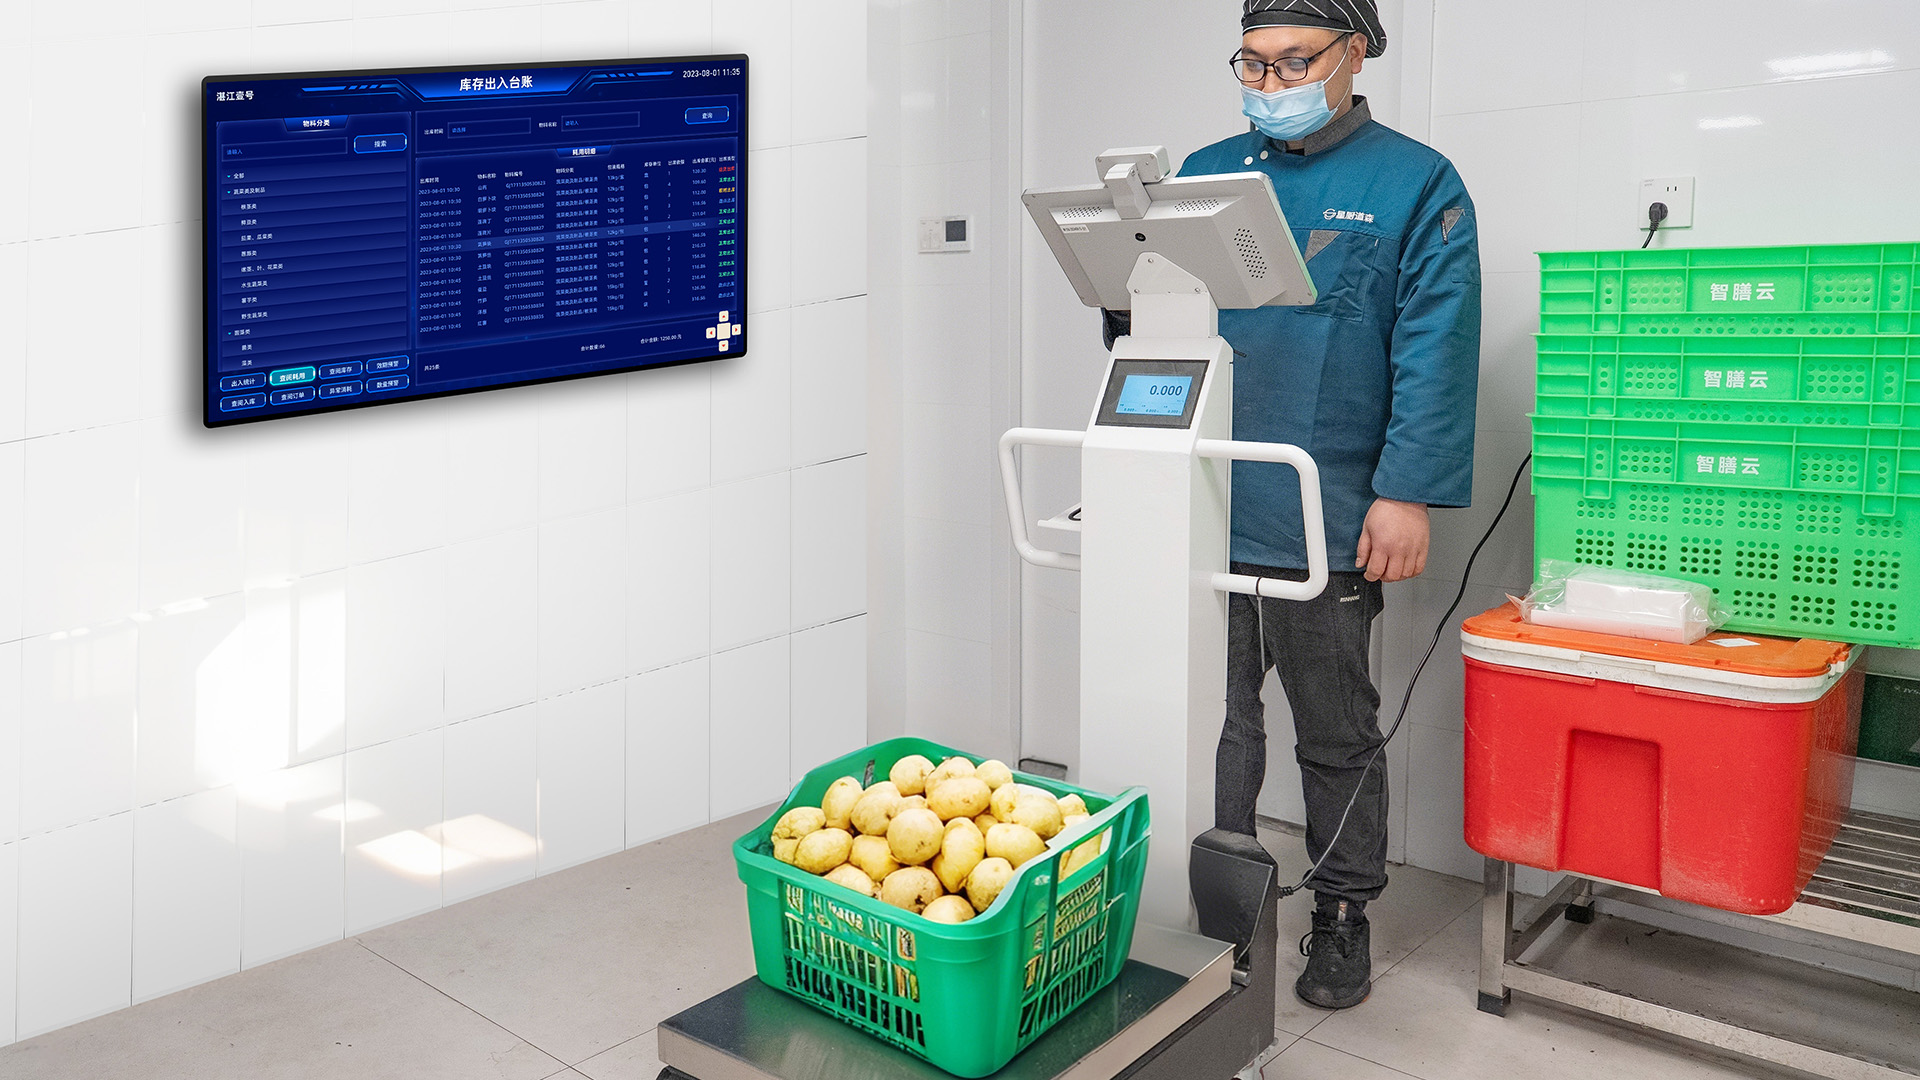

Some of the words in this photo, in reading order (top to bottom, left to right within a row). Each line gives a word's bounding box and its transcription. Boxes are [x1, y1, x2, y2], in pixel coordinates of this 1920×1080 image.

[683, 69, 720, 78] 2023-08-01
[723, 68, 740, 76] 11:35
[459, 75, 533, 92] 库存出入台账
[217, 90, 254, 102] 湛江壹号
[303, 119, 330, 128] 物料分类
[374, 140, 387, 148] 搜索
[1710, 282, 1776, 302] 智膳云
[231, 378, 255, 387] 出入统计
[1703, 369, 1769, 389] 智膳云
[1149, 384, 1184, 397] 0.000
[1695, 454, 1761, 475] 智膳云
